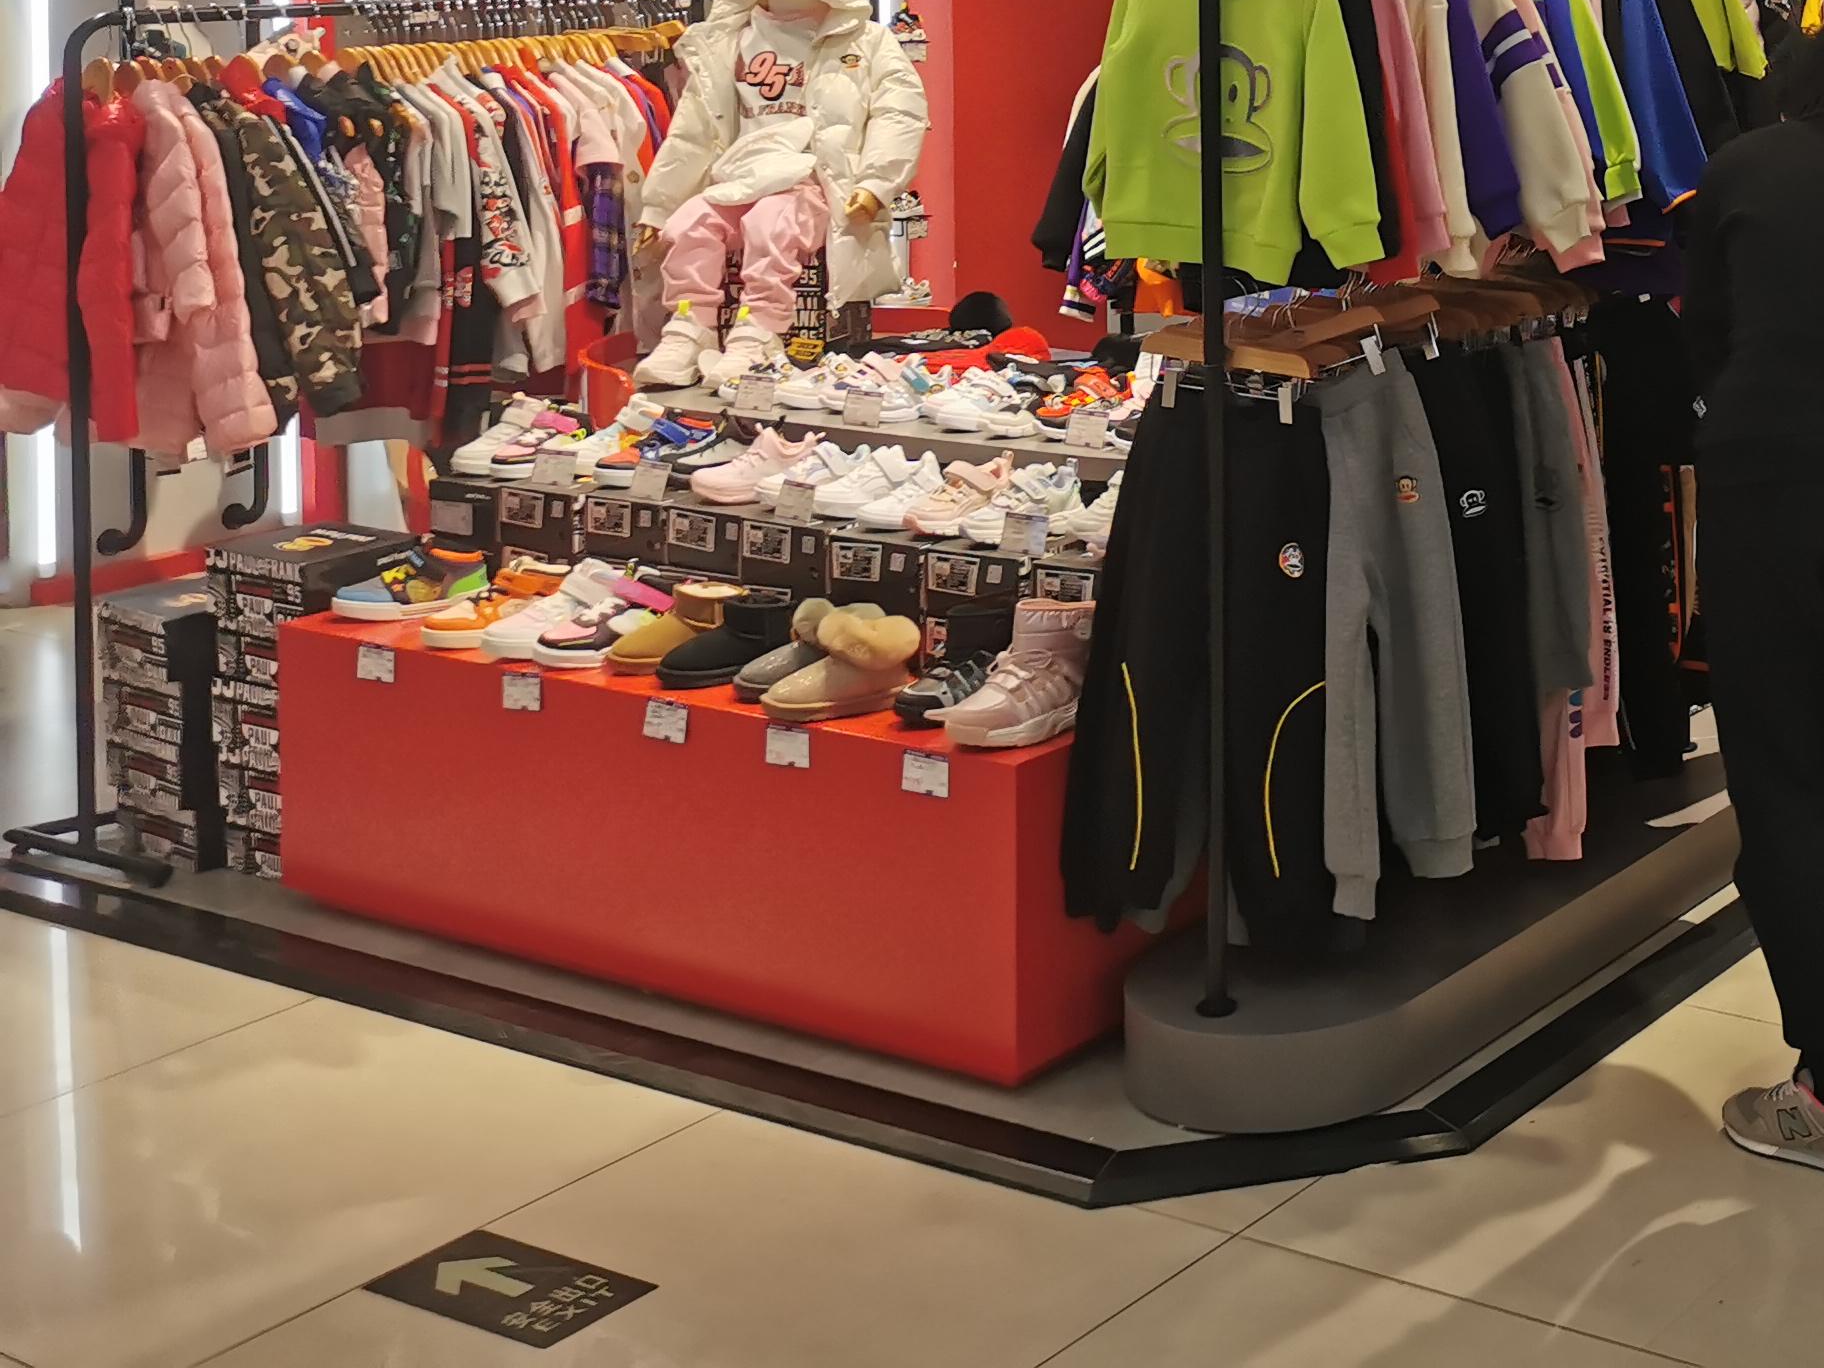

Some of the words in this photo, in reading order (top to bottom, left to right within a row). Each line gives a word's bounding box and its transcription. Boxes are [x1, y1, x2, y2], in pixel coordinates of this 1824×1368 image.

[745, 51, 792, 102] 95
[286, 584, 303, 604] 95
[500, 1273, 610, 1329] 安全出口
[533, 1285, 615, 1333] EXIT
